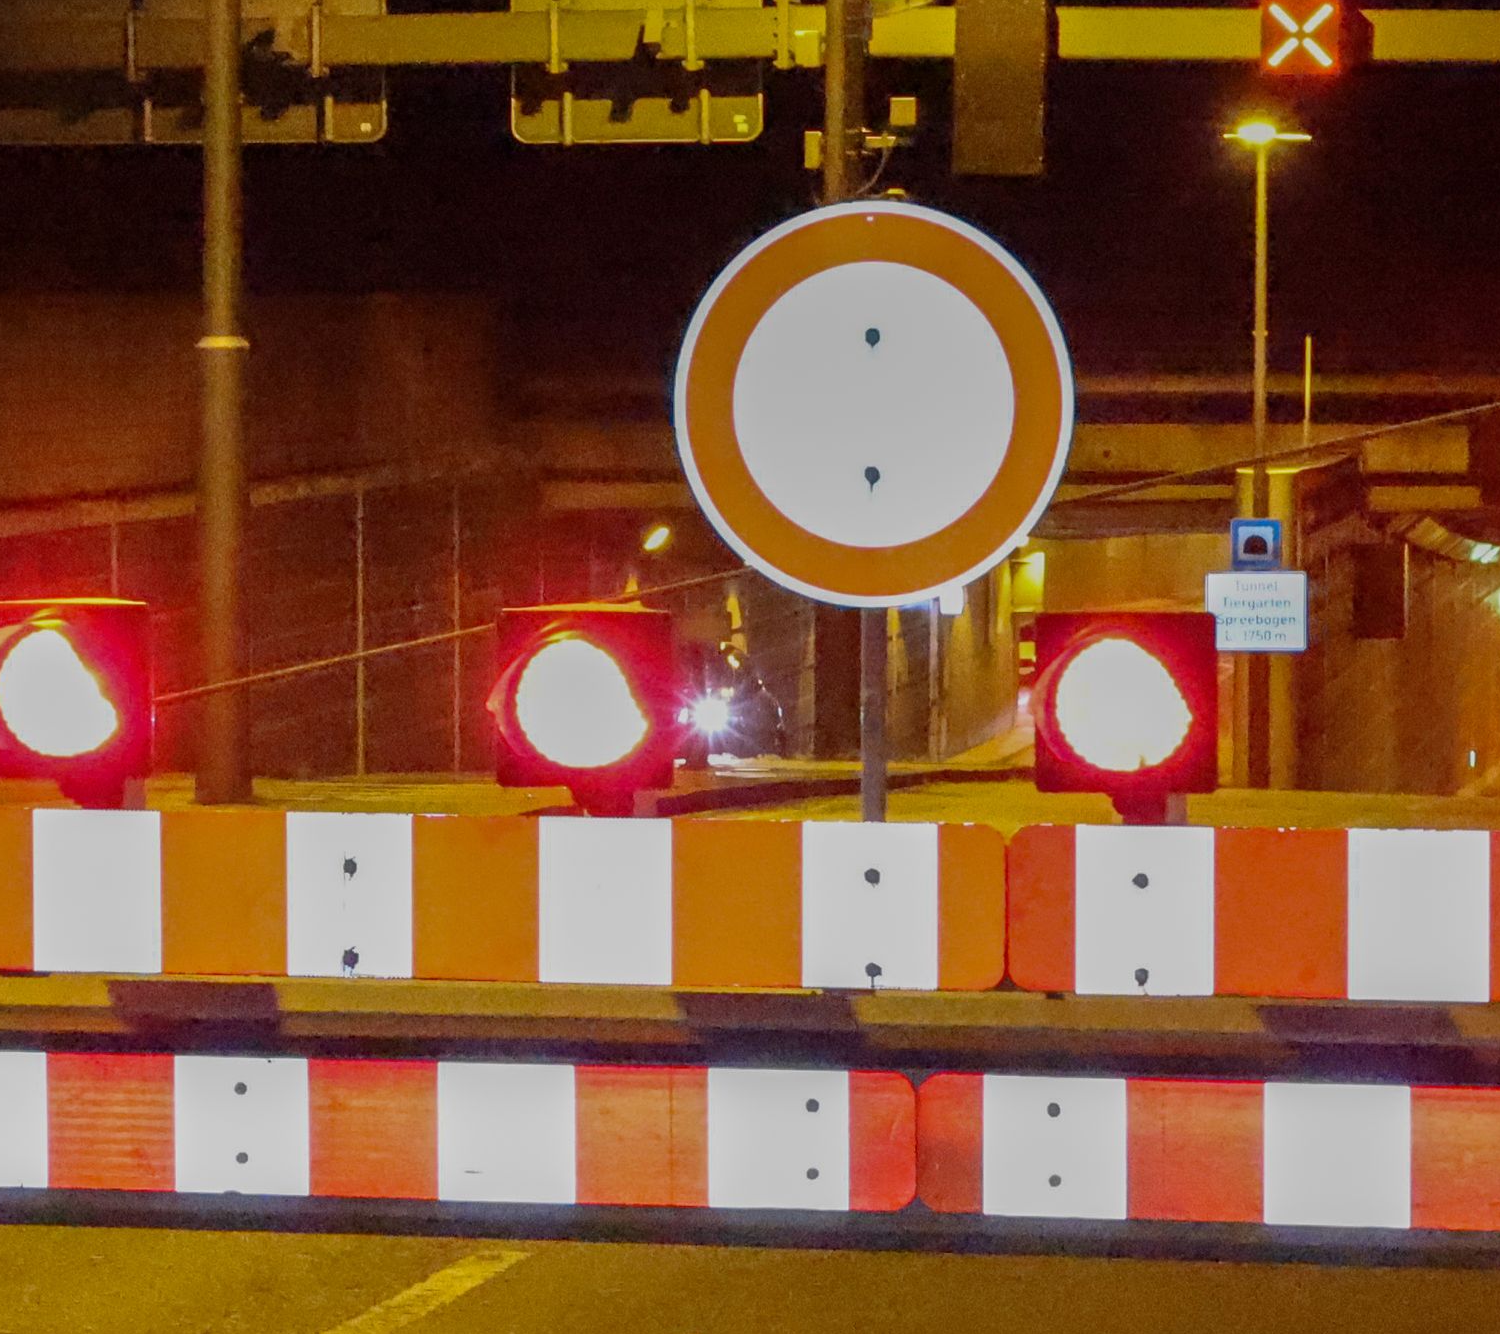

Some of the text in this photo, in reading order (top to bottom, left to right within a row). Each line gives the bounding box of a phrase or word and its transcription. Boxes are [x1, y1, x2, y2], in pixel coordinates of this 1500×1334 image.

[1235, 580, 1278, 592] Tunnel
[1223, 596, 1291, 610] Tiergarten
[1216, 615, 1296, 628] Spreebogen
